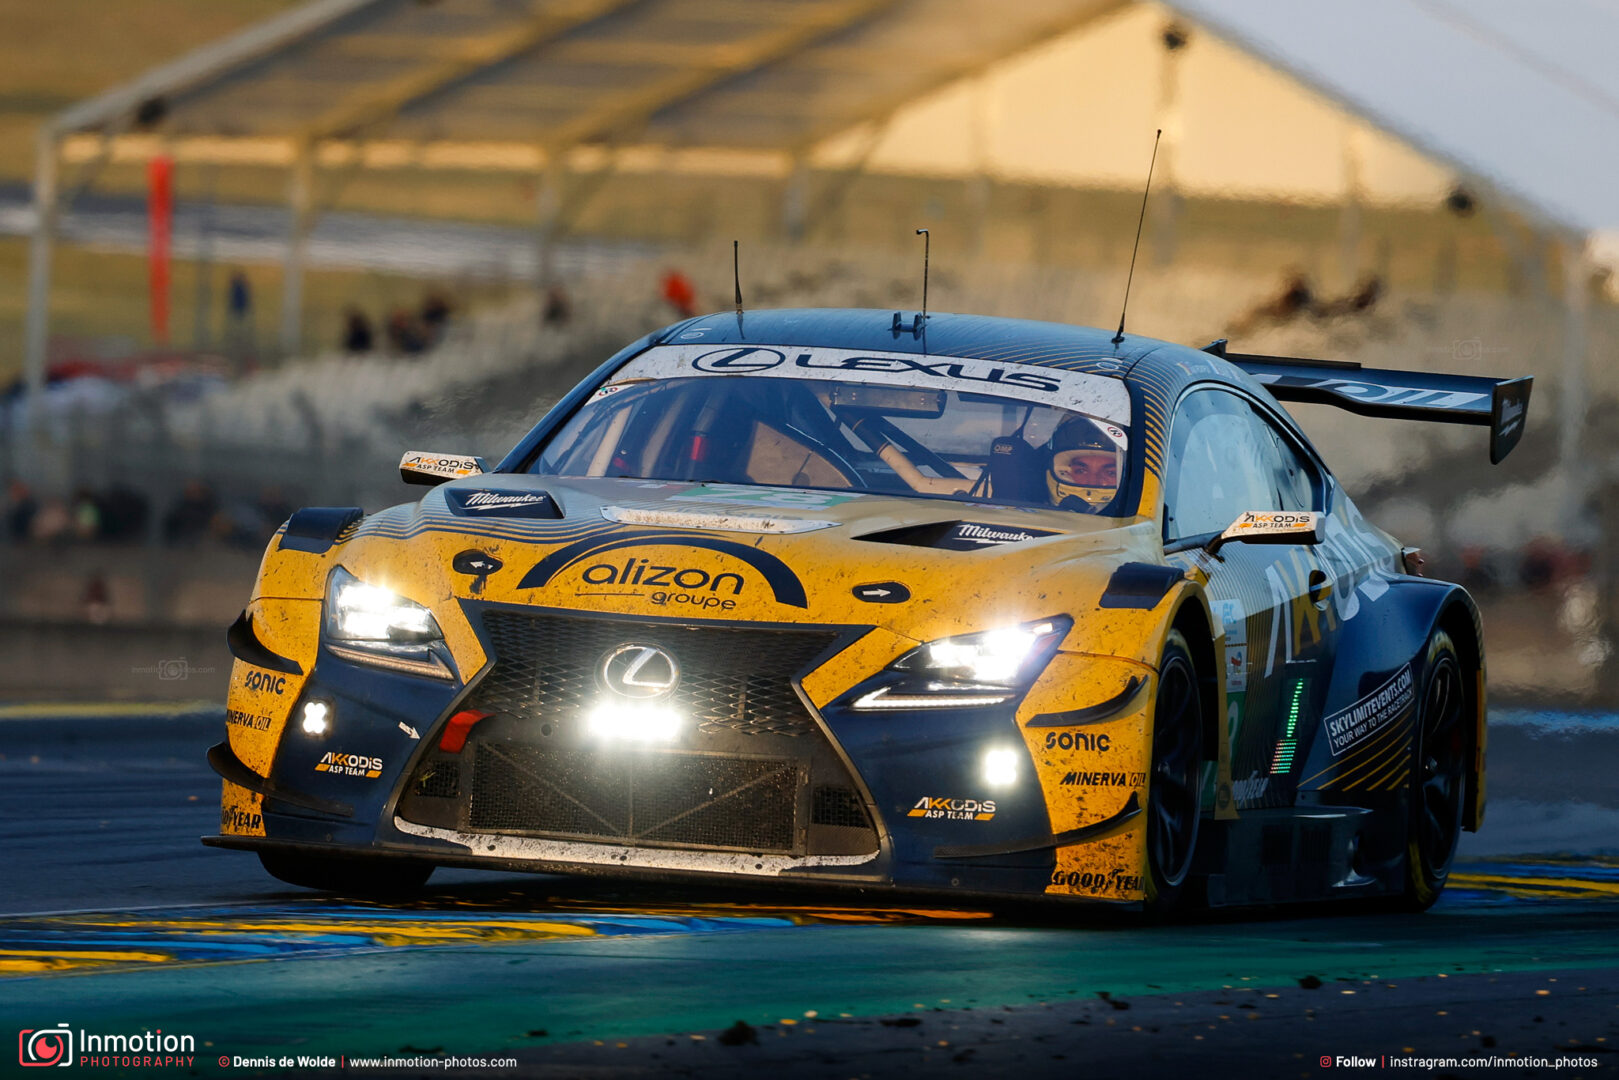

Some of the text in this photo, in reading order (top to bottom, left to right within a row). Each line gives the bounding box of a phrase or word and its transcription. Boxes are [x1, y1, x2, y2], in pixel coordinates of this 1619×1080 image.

[795, 353, 1062, 392] LEXUS
[433, 465, 455, 474] TEAM
[465, 491, 545, 506] Milwaukee
[582, 556, 745, 596] alizon
[651, 591, 738, 611] groupe
[1329, 669, 1412, 737] SKYLIMITEVENTS.COM
[1333, 730, 1355, 748] YOUR
[1354, 722, 1368, 738] WAY
[1368, 715, 1378, 729] TO
[1376, 709, 1389, 723] THE
[328, 765, 366, 777] ASP TEAM
[1059, 771, 1127, 787] MINERVA
[925, 809, 945, 819] ASP
